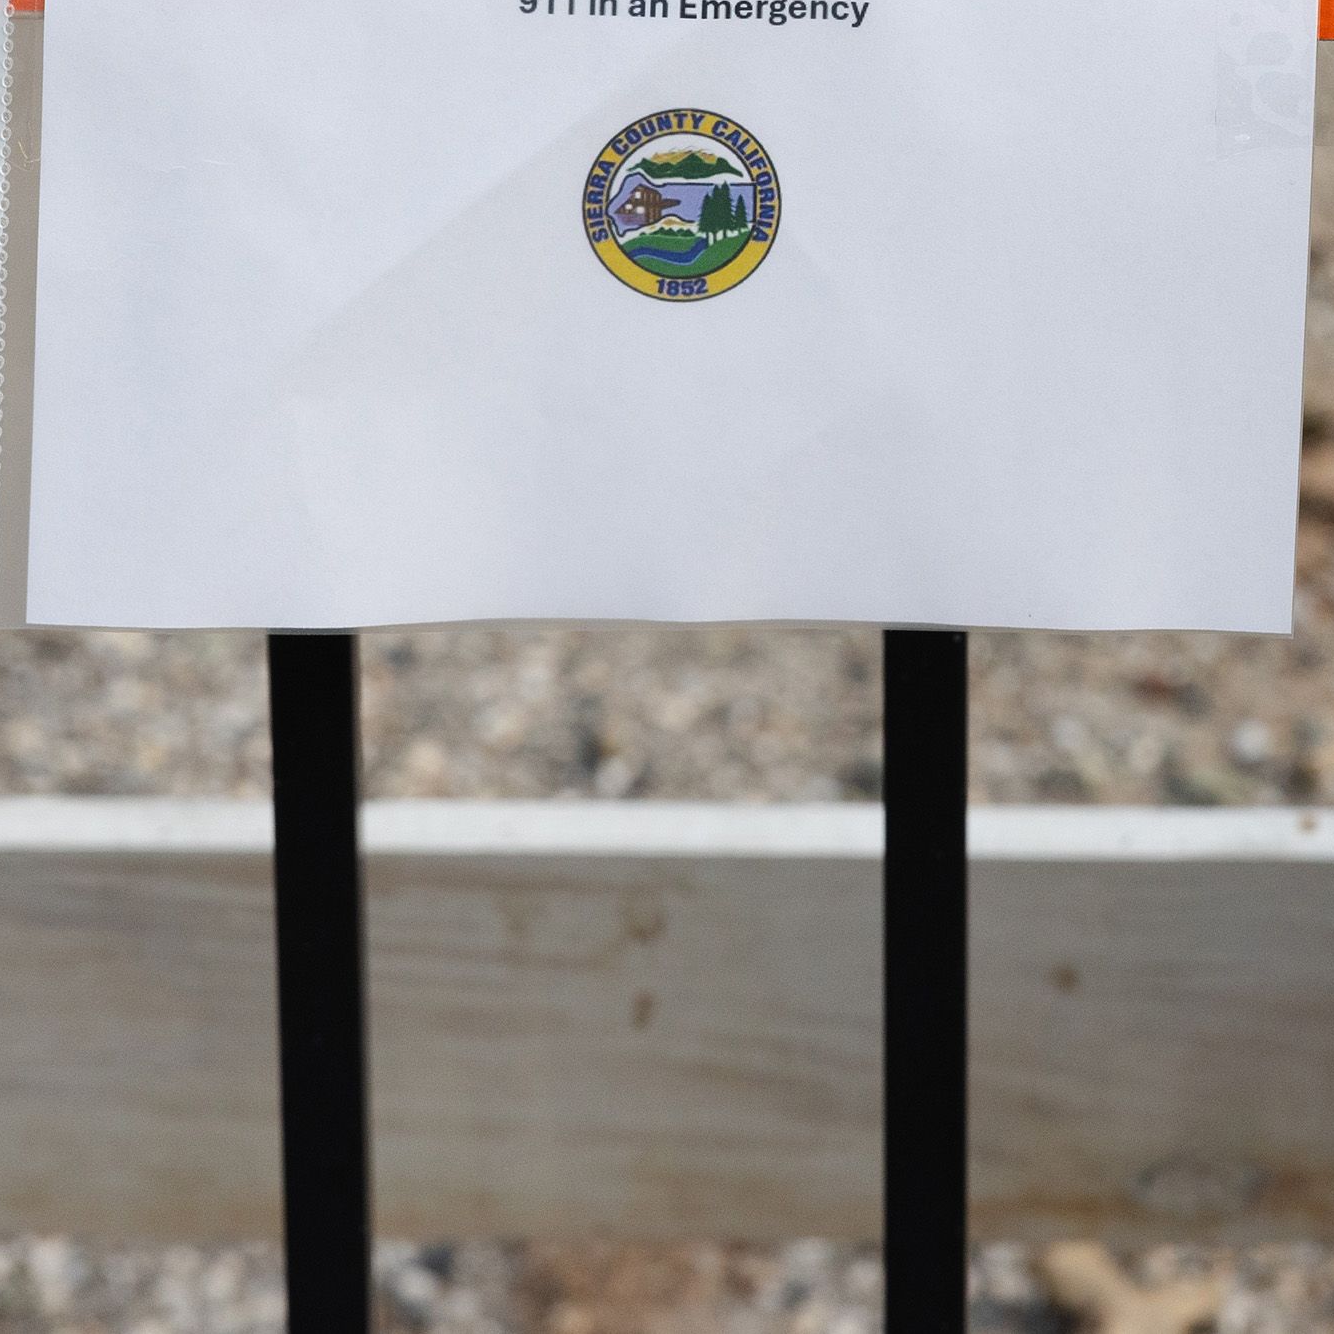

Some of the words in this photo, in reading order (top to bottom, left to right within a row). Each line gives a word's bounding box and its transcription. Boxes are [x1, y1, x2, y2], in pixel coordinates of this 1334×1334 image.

[587, 160, 616, 243] SIERRA
[611, 113, 705, 156] COUNTY
[711, 119, 776, 243] CALIFORNIA
[655, 277, 709, 297] 1852
